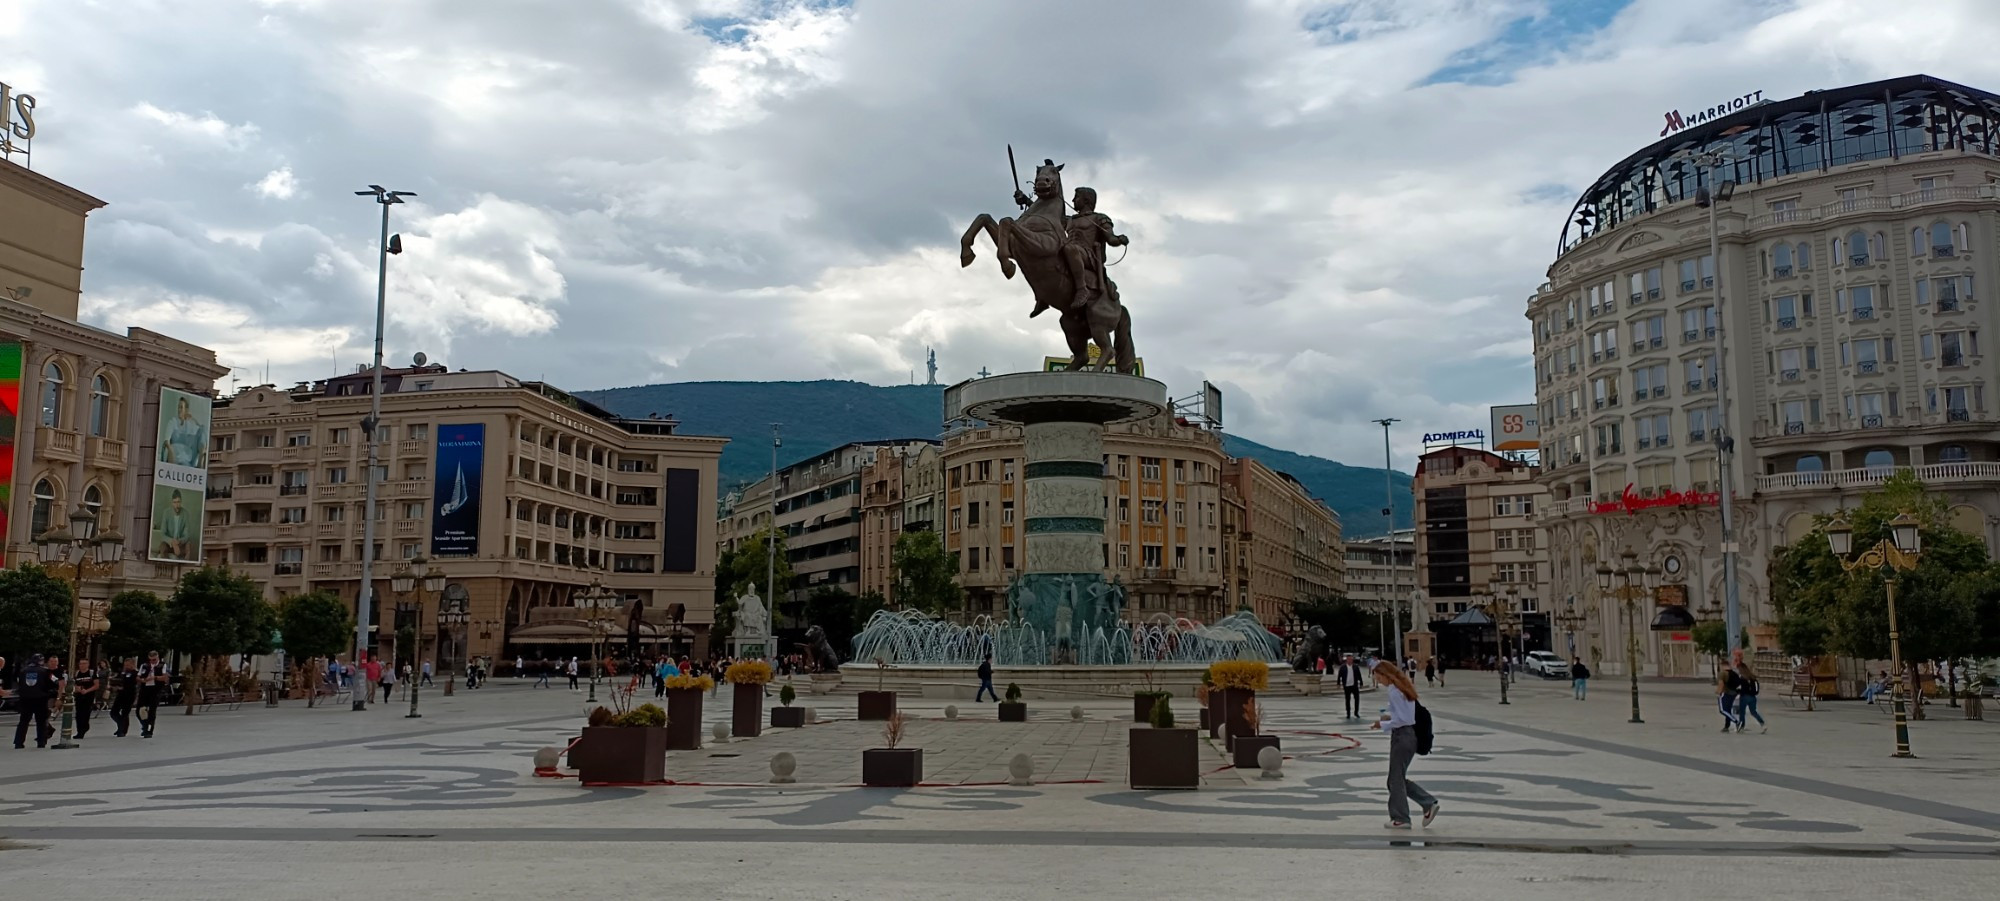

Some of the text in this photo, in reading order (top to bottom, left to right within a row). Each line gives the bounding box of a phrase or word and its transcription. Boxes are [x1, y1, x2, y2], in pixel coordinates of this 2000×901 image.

[1686, 90, 1762, 126] MARRIOTT
[1422, 429, 1484, 443] ADMIRAL
[158, 468, 203, 485] CALLIOPE
